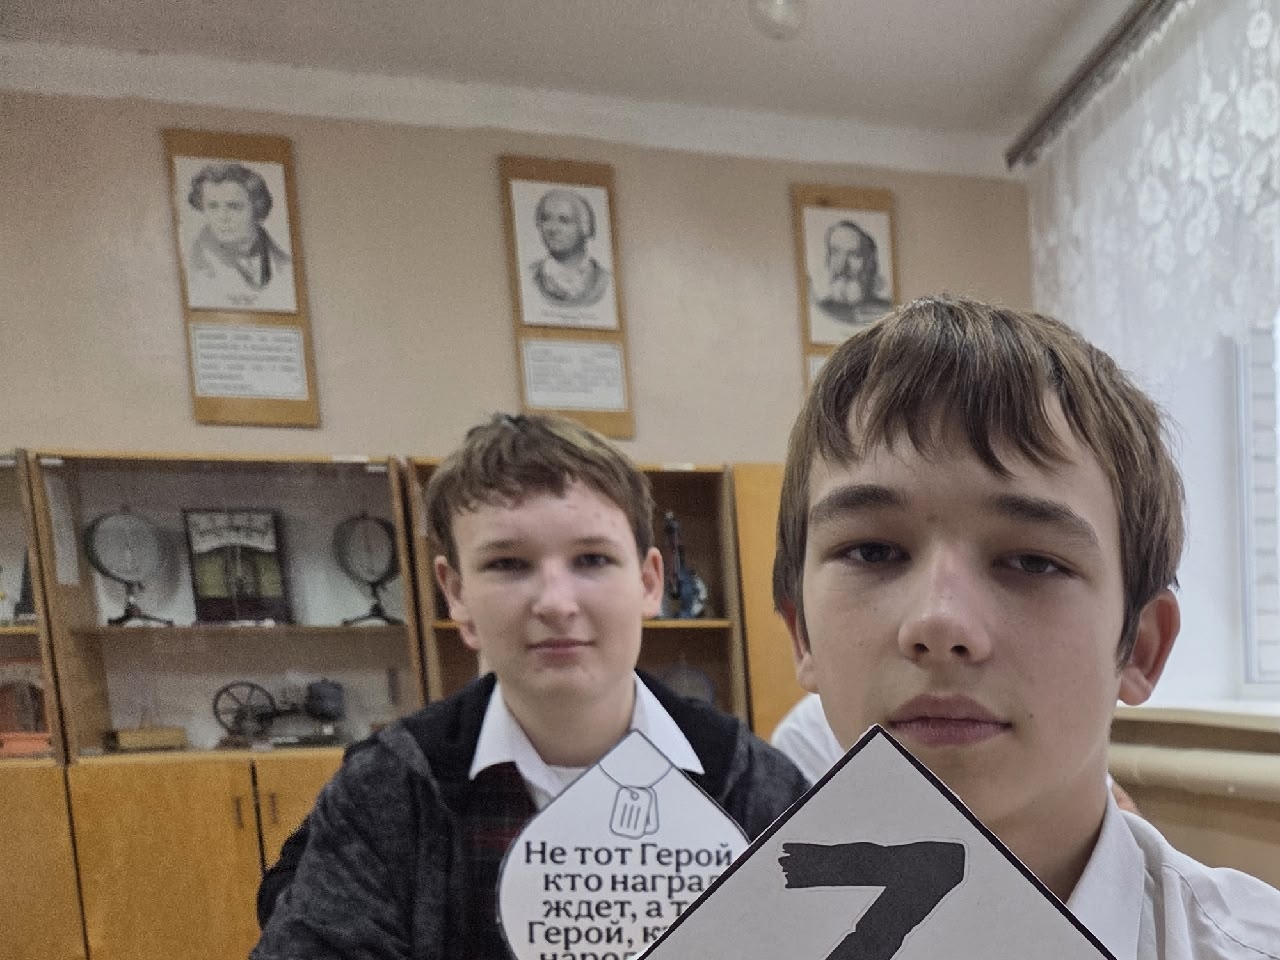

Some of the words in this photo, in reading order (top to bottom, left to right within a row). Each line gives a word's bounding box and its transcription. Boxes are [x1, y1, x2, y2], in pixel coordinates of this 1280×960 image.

[524, 841, 567, 865] Не
[574, 846, 633, 866] тот
[640, 843, 732, 872] Герой
[543, 873, 603, 893] кто
[542, 900, 637, 921] ждет,
[645, 900, 663, 918] а
[528, 921, 633, 950] Герой,
